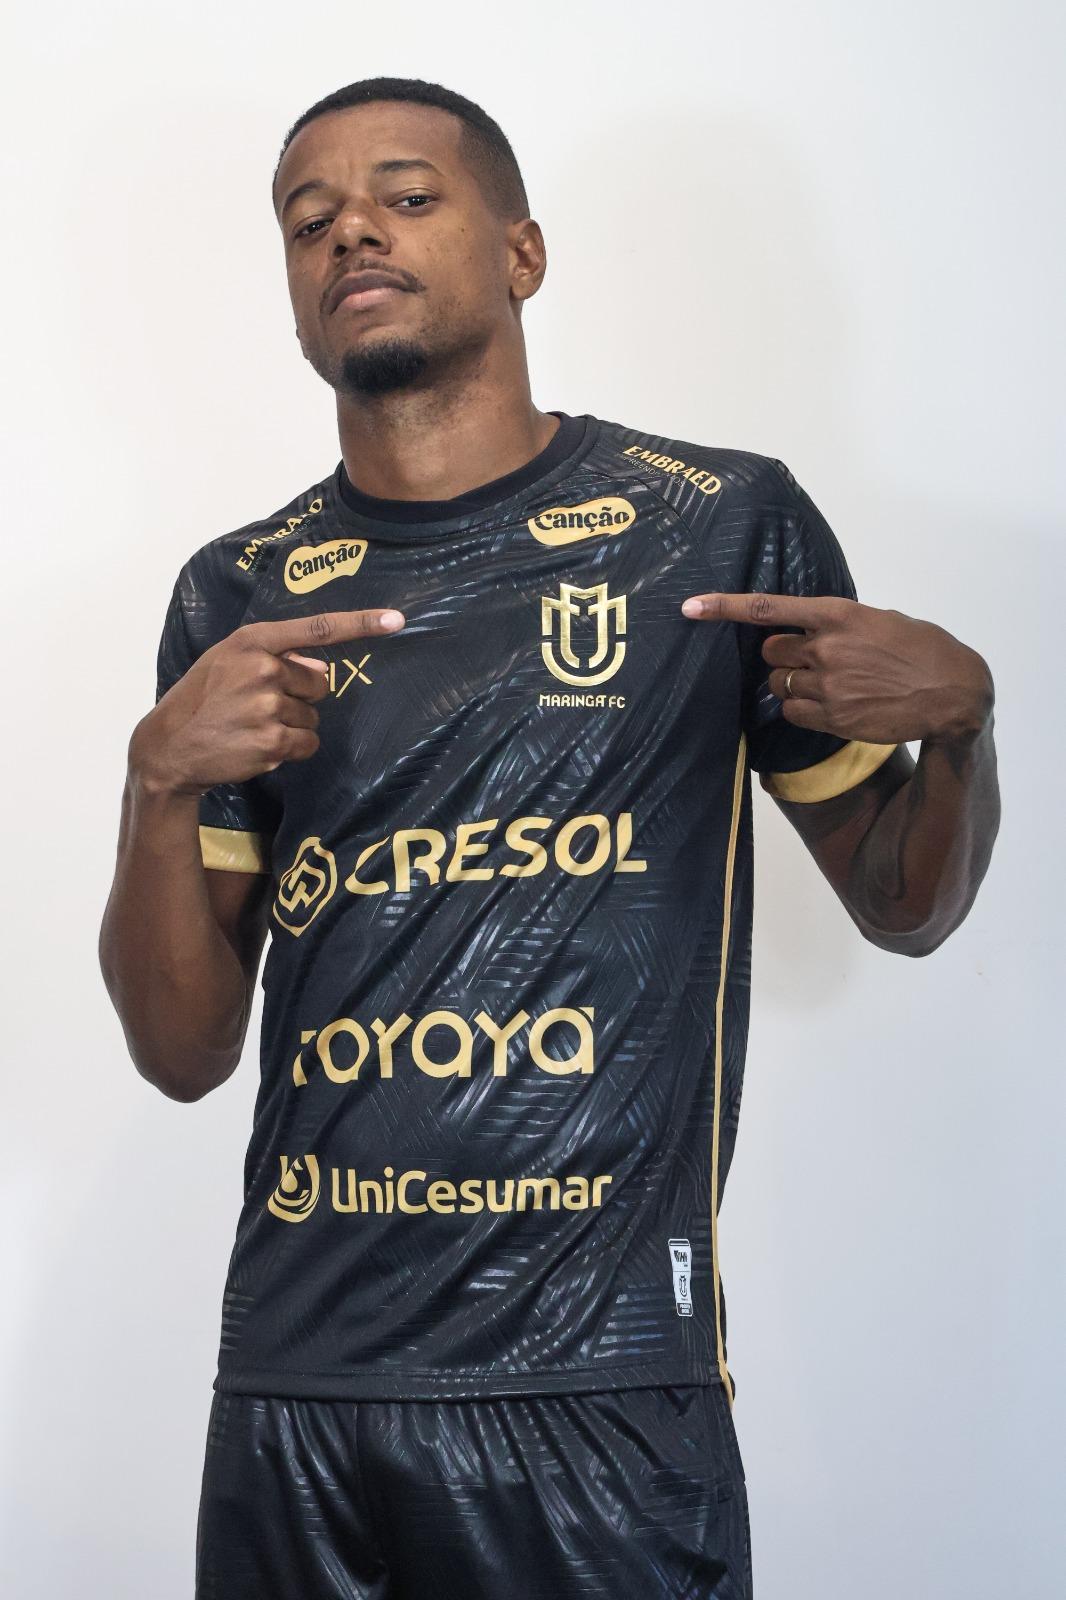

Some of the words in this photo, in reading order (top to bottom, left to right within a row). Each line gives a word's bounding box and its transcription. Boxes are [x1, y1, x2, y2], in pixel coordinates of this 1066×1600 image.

[622, 445, 722, 495] EMBRAED
[236, 498, 323, 571] EMBRAD
[533, 506, 630, 534] Canção
[288, 543, 362, 582] Canção
[324, 653, 373, 698] IX
[608, 695, 626, 709] FC
[344, 811, 648, 896] CRESOL
[331, 1166, 613, 1214] UniCesumar
